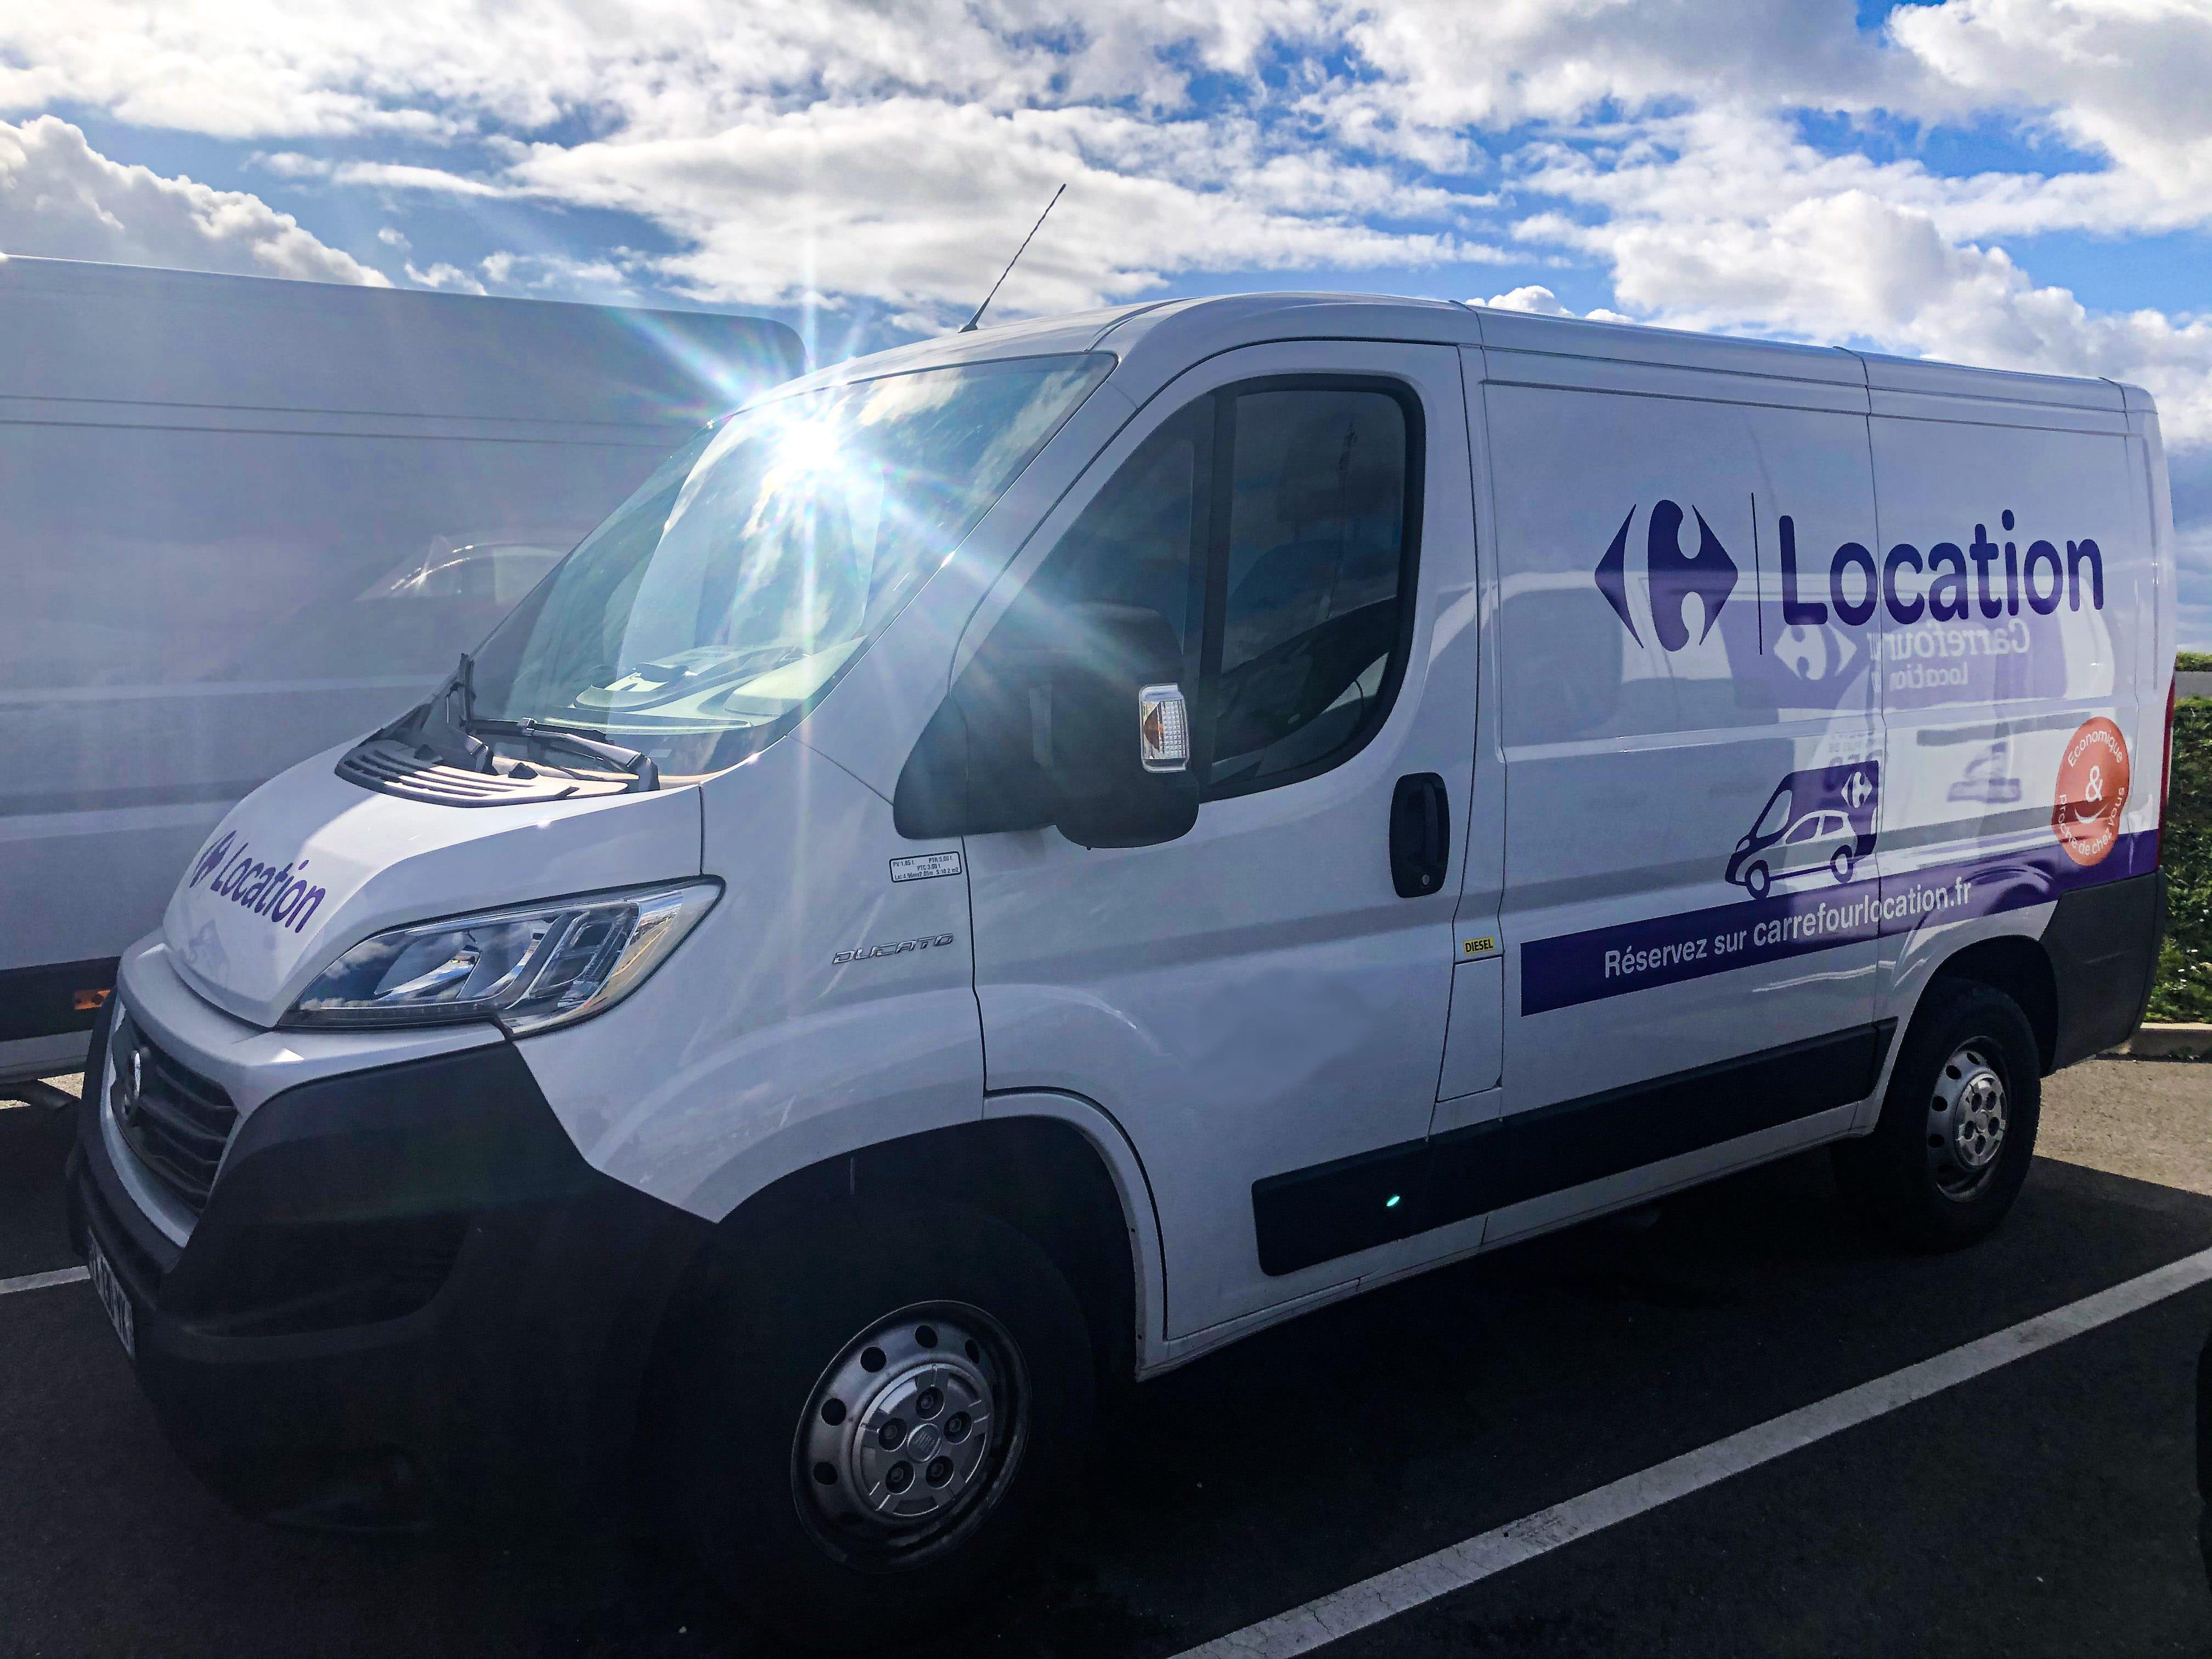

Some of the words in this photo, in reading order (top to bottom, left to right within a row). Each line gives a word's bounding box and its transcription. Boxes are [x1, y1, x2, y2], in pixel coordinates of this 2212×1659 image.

[1779, 509, 2103, 625] Location
[2085, 766, 2103, 803] &
[2058, 794, 2078, 849] proche
[2079, 842, 2091, 855] de
[2092, 827, 2113, 854] chez
[2108, 787, 2125, 826] vous
[210, 843, 326, 933] Location
[832, 933, 953, 964] DUCATO
[1465, 939, 1493, 952] DIESEL
[1605, 938, 1707, 978] Réservez
[1714, 930, 1747, 955] sur
[1753, 877, 1971, 946] carrefourlocation.fr
